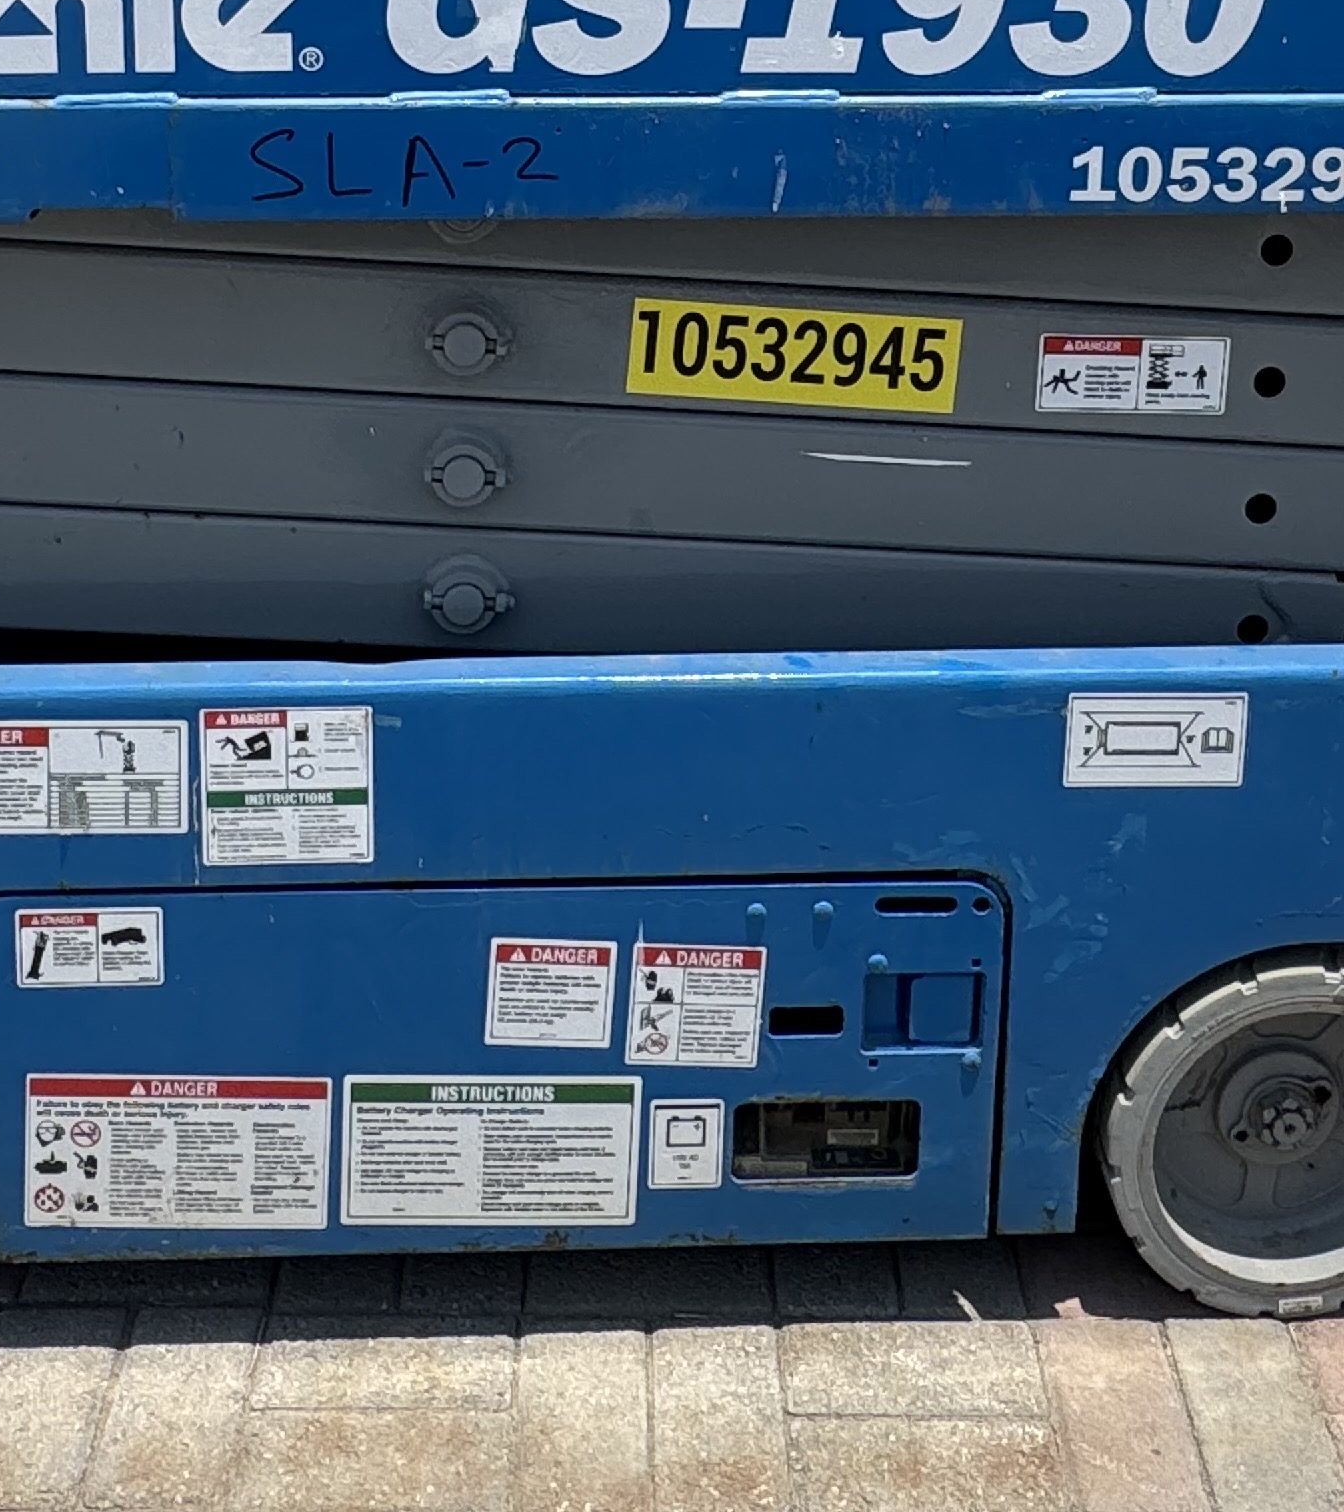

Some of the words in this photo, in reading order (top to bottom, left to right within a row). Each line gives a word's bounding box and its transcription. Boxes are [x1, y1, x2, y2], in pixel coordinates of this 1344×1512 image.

[250, 128, 559, 208] SLA-2
[638, 309, 948, 392] 10532945
[1074, 340, 1122, 352] DANGER
[231, 712, 281, 726] DANGER
[244, 792, 335, 806] INSTRUCTIONS
[530, 947, 598, 964] DANGER
[676, 951, 745, 968] DANGER
[150, 1080, 219, 1096] DANGER
[430, 1085, 556, 1102] INSTRUCTIONS
